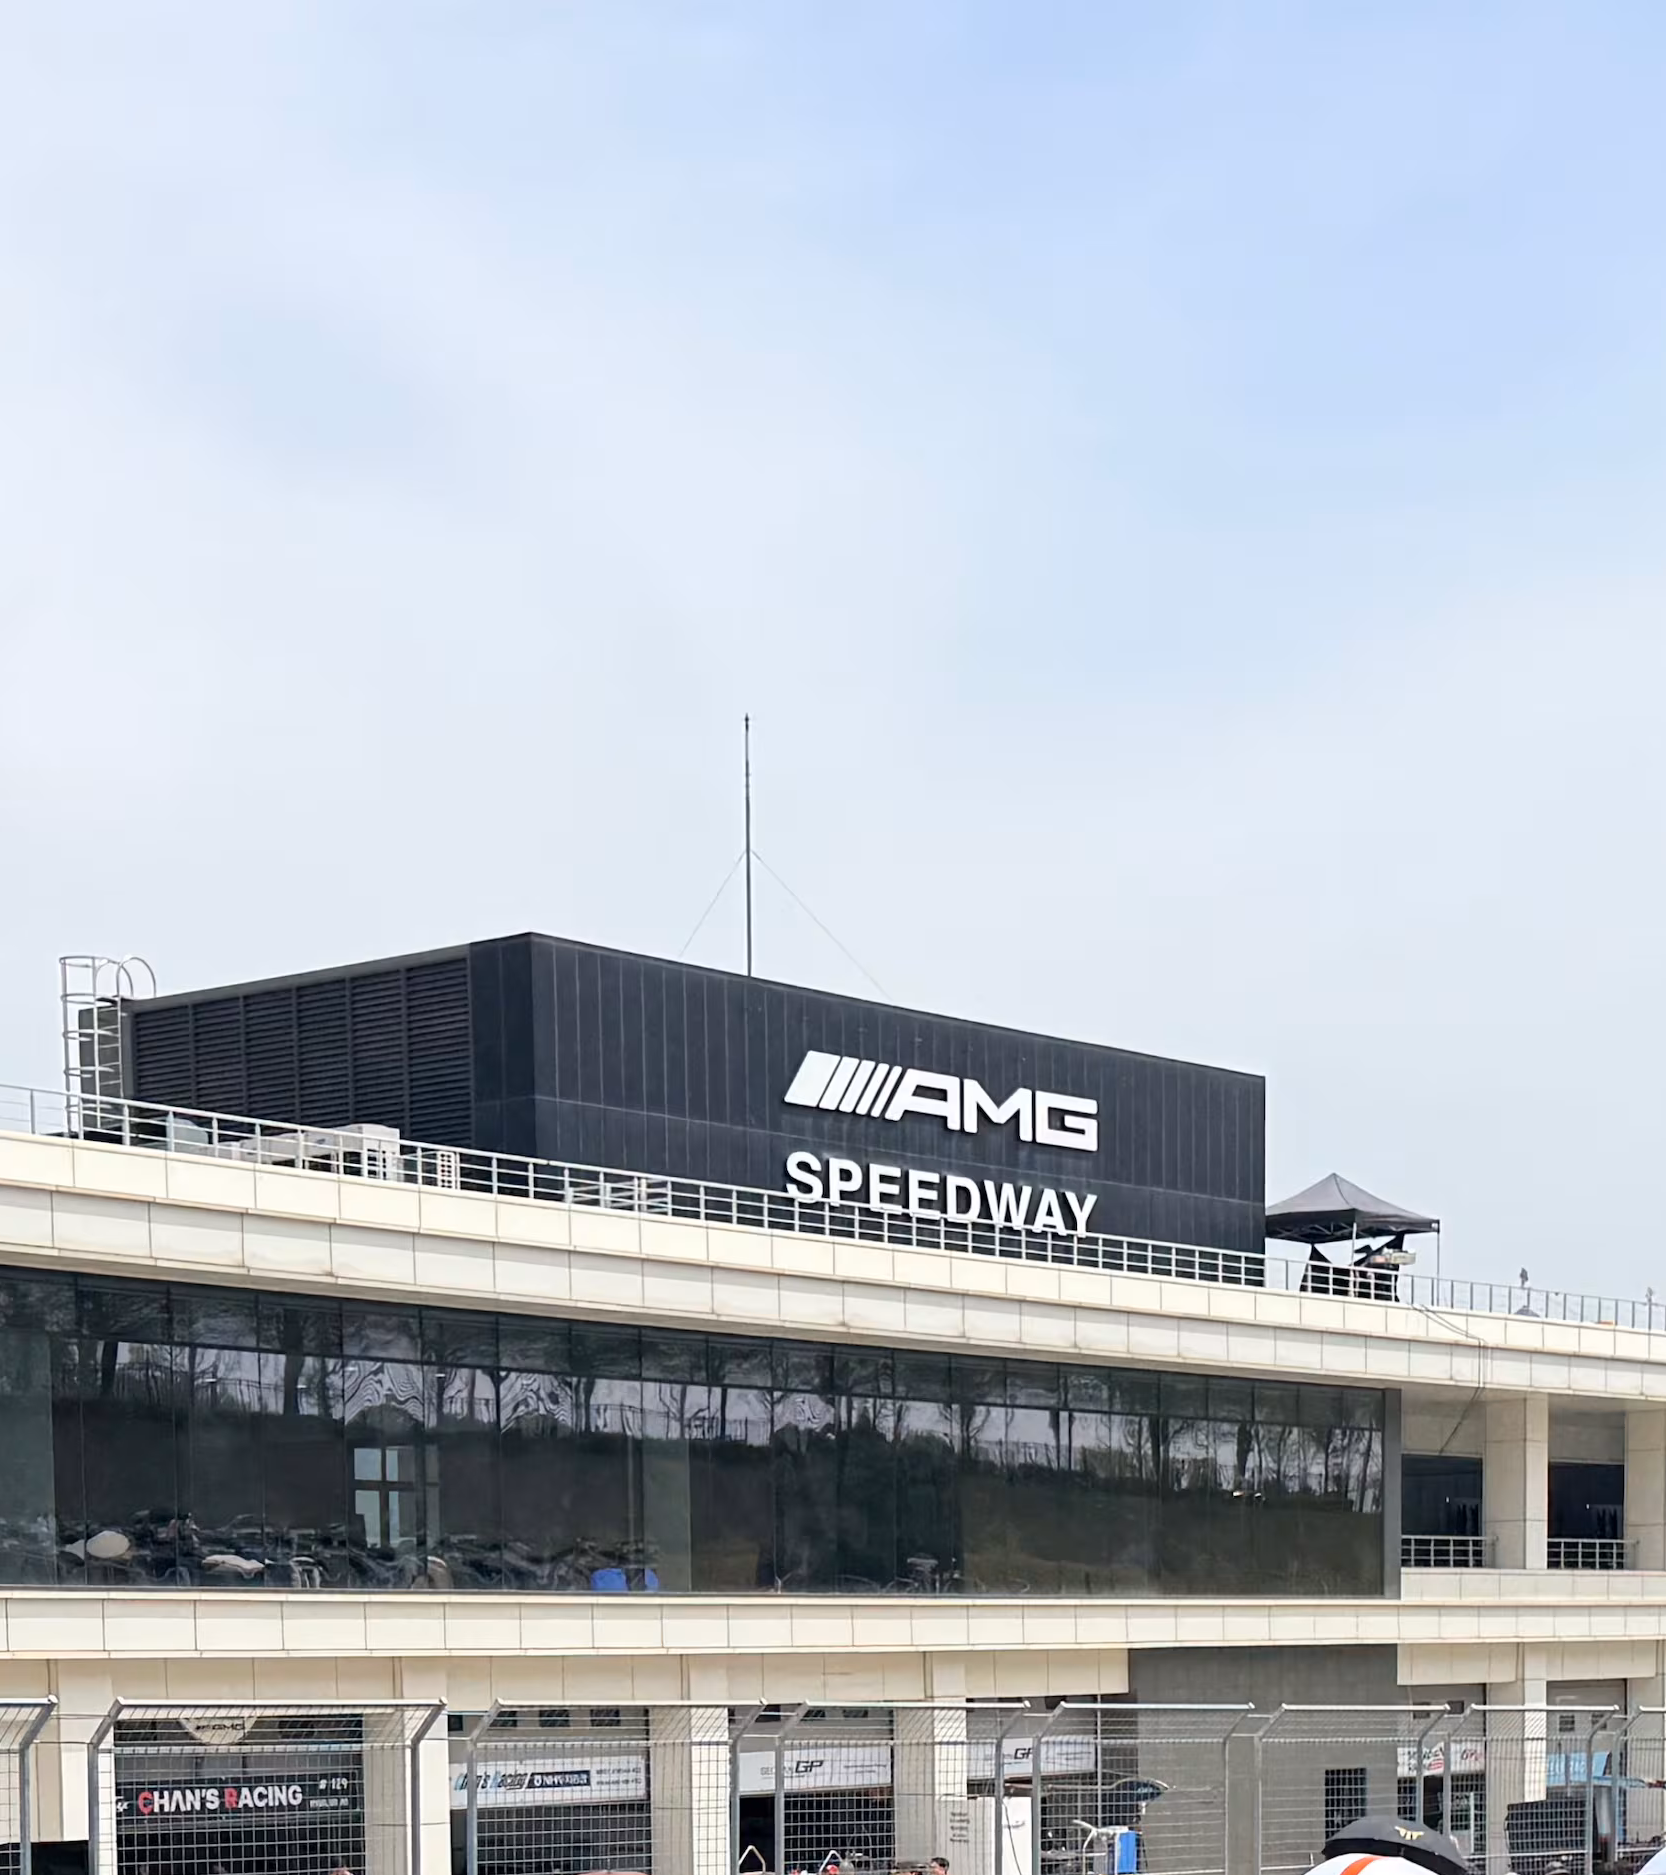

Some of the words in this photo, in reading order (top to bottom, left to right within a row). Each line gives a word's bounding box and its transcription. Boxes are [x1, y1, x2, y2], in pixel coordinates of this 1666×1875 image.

[885, 1067, 1098, 1151] AMG
[785, 1151, 1098, 1237] SPEEDWAY
[139, 1787, 219, 1815] CHAN'S
[224, 1785, 303, 1810] RACING
